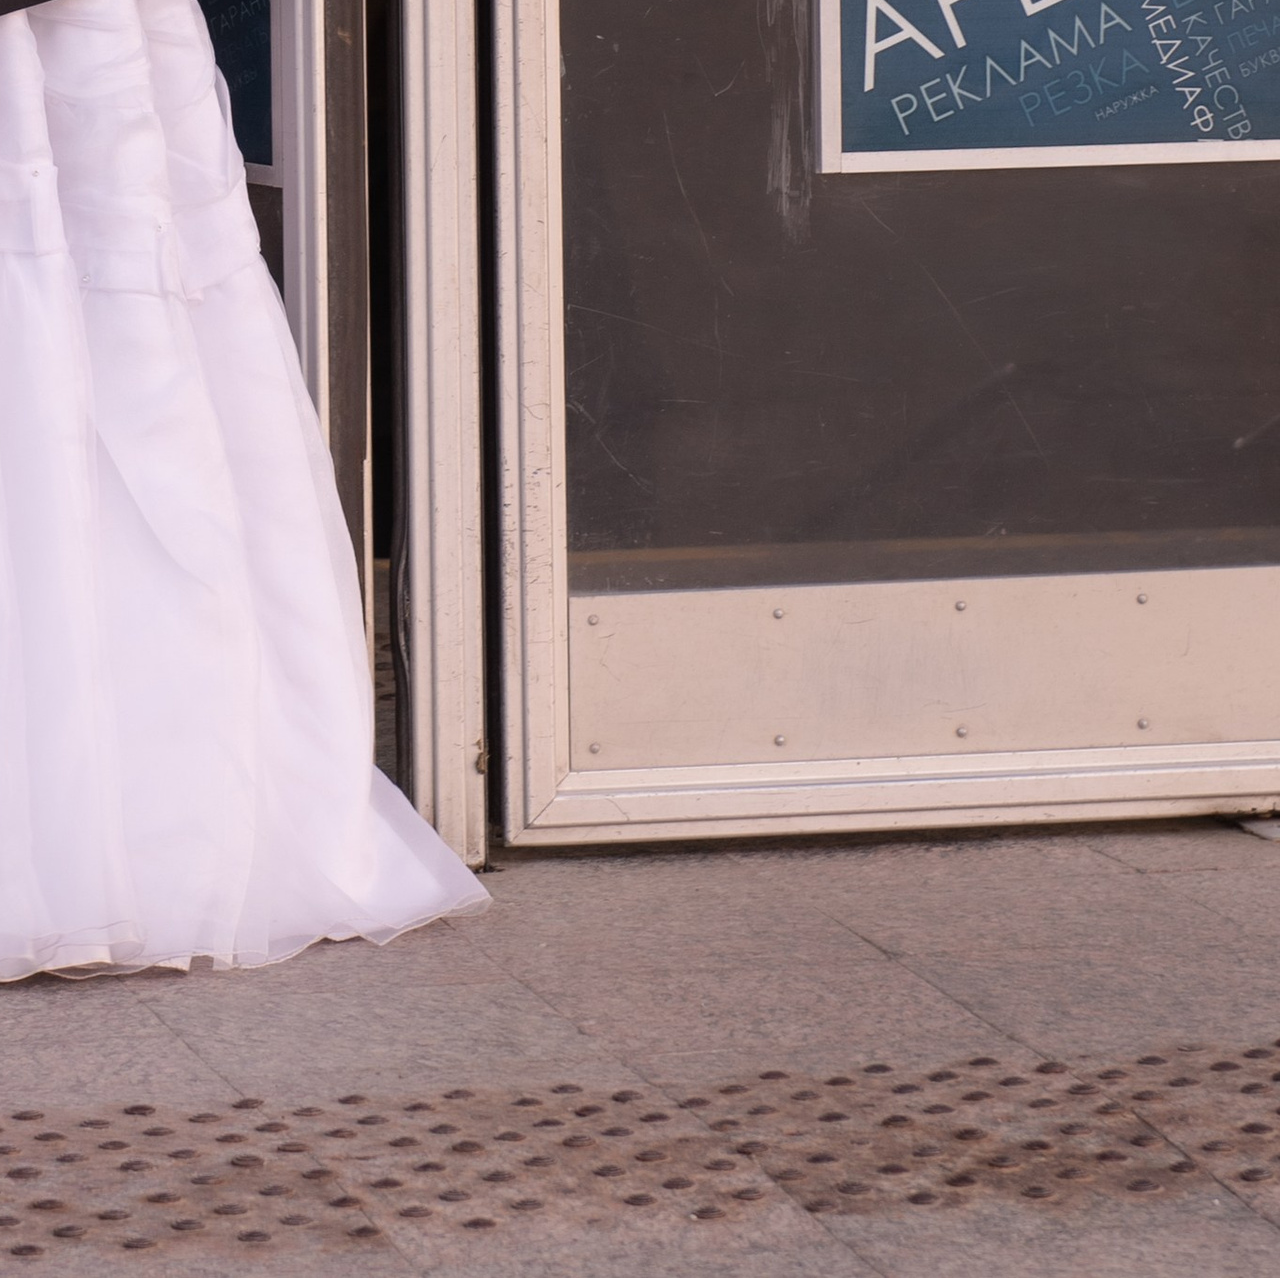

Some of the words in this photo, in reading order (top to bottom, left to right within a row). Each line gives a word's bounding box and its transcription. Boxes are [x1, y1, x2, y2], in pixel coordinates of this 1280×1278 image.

[890, 2, 1133, 136] РЕКЛАМА
[1018, 48, 1150, 128] РЕЗКА
[1094, 84, 1160, 122] НАРУЖКА
[1181, 11, 1253, 141] КАЧЕСТВ
